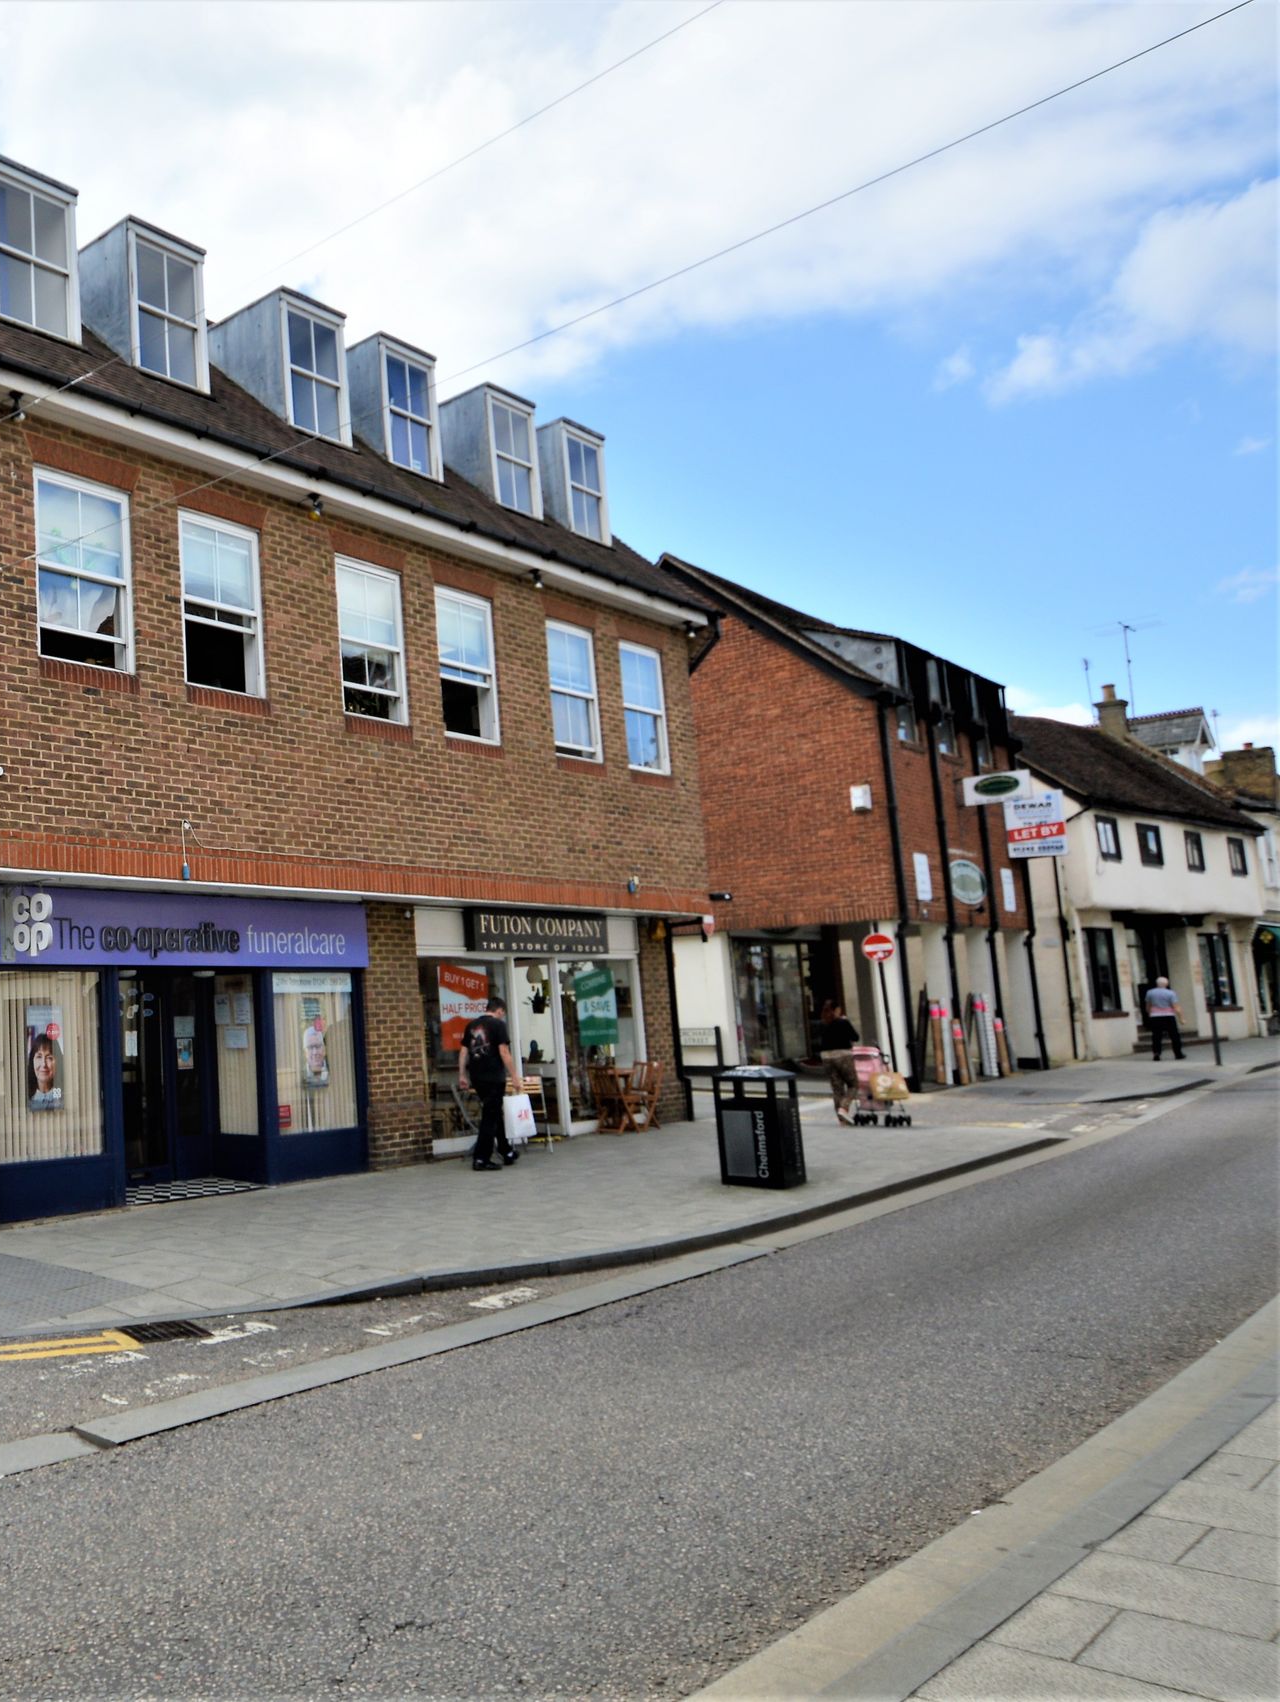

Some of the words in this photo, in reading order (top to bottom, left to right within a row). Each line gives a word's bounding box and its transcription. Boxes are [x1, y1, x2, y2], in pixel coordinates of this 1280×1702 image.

[1013, 828, 1039, 841] LET
[1040, 824, 1060, 836] BY
[480, 914, 532, 935] FUTON
[535, 917, 603, 938] COMPANY
[53, 917, 95, 950] The
[246, 924, 346, 956] funeralcare
[483, 942, 504, 950] THE
[512, 942, 548, 951] STORE
[554, 944, 567, 952] OF
[573, 944, 604, 953] IDEAS
[444, 971, 460, 985] BUY
[465, 977, 480, 989] GET
[442, 1003, 464, 1014] HALF
[464, 1002, 487, 1013] PRICE
[590, 1000, 611, 1013] SAVE
[753, 1110, 770, 1179] Chelmsford
